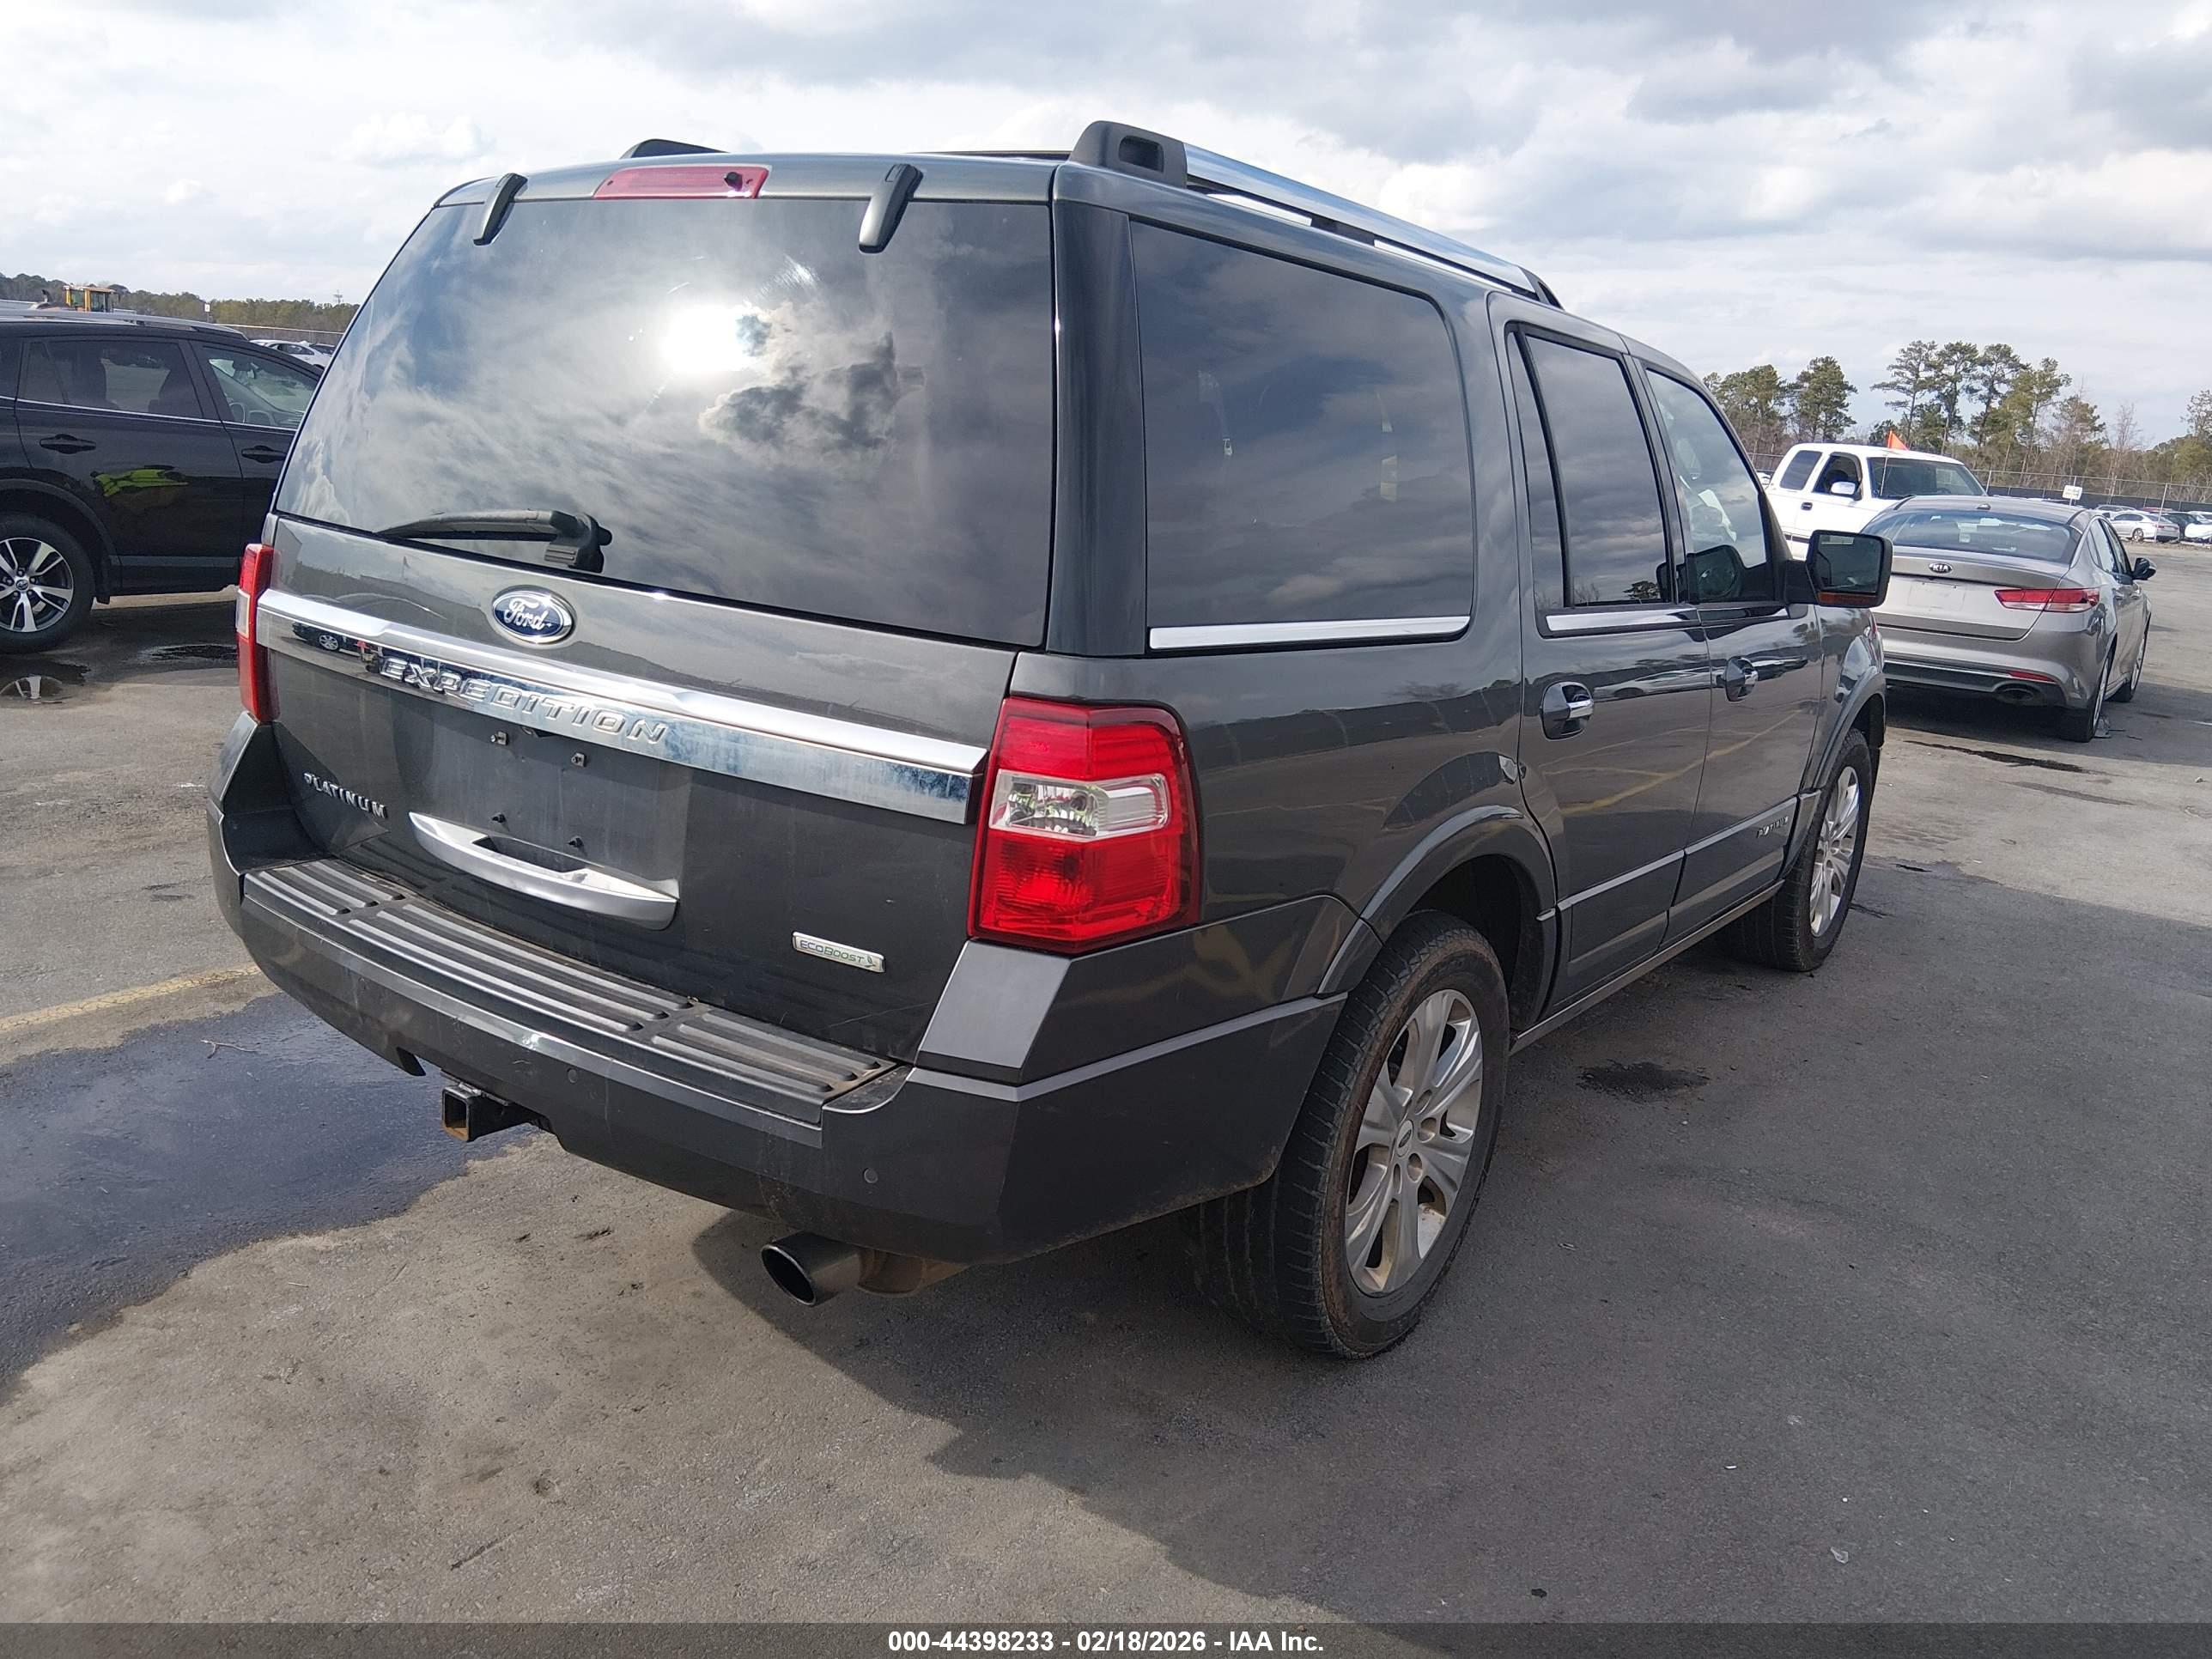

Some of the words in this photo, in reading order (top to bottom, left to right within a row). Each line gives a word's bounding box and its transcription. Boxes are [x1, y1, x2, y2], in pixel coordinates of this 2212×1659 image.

[503, 598, 550, 630] Ford
[379, 656, 668, 744] EXPEDITION
[304, 772, 386, 819] PLATINUM
